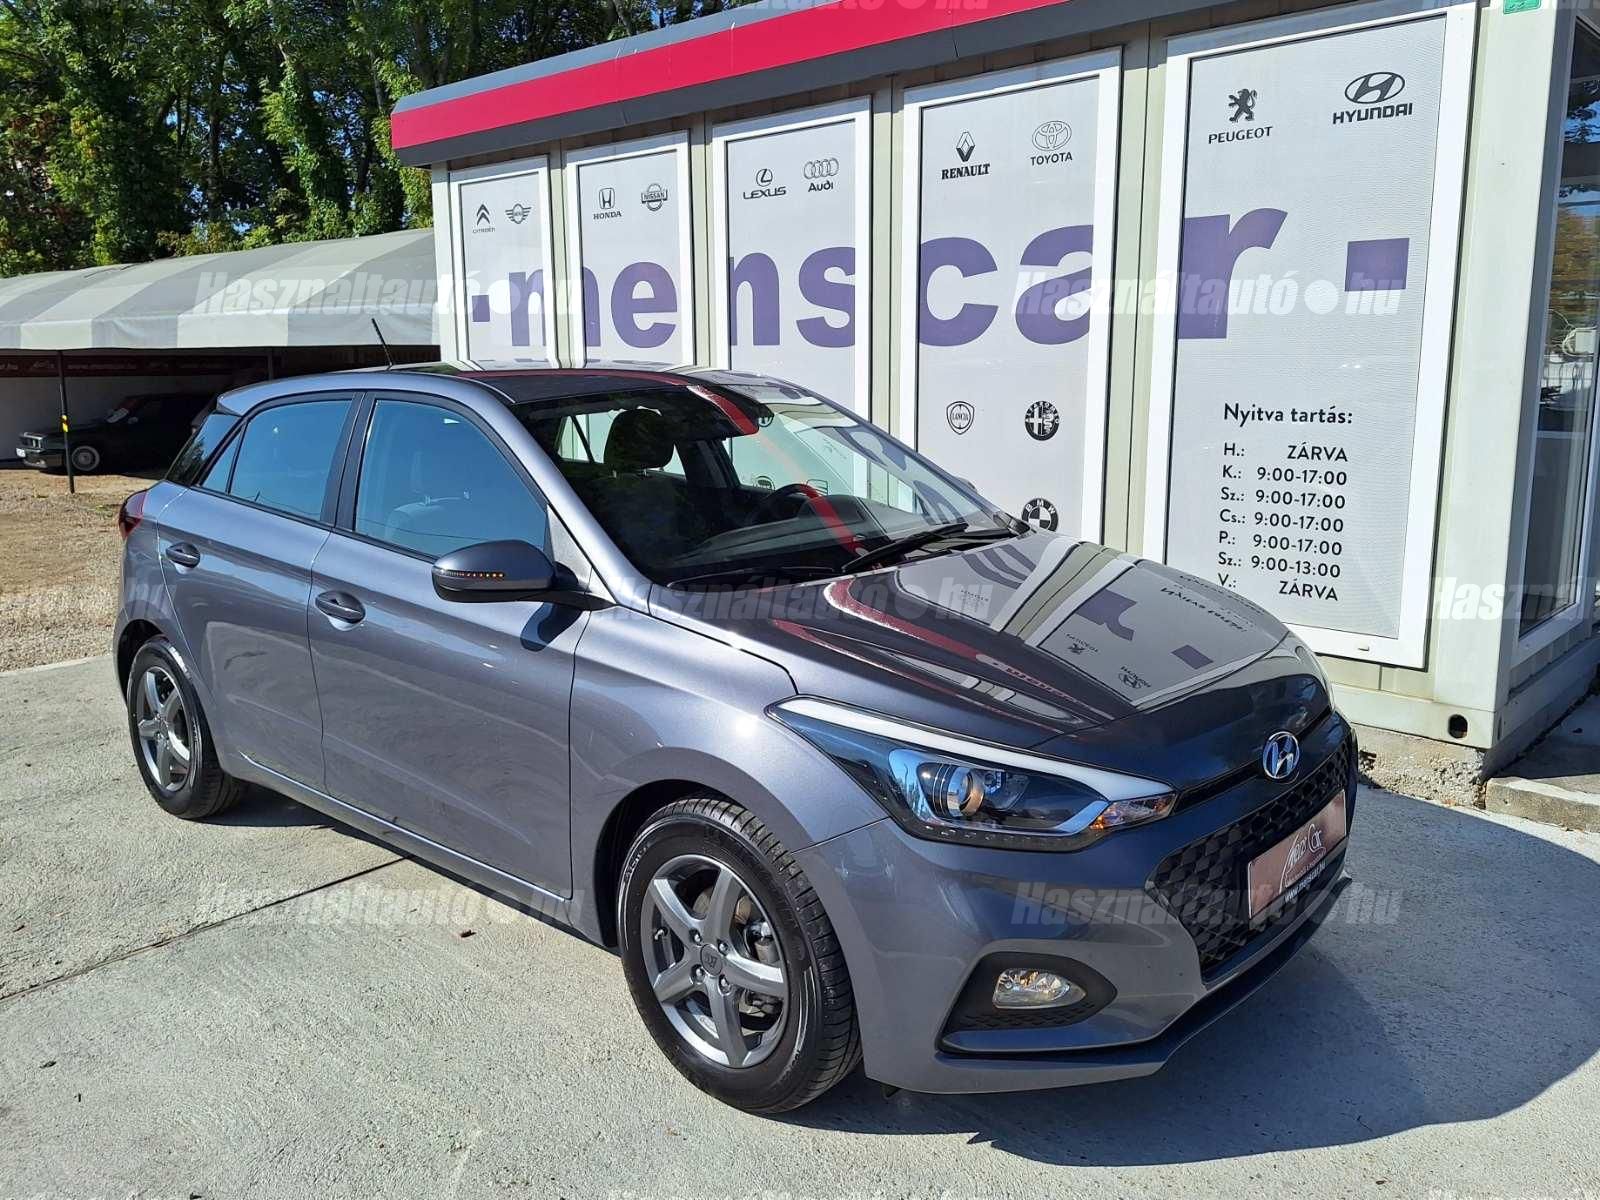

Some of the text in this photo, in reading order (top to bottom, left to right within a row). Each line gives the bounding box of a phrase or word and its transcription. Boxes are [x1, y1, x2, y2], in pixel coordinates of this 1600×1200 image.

[1332, 102, 1413, 124] HYUNDAI
[1208, 126, 1273, 144] PEUGEOT
[1030, 151, 1073, 166] TOYOTA
[941, 163, 991, 180] RENAULT
[643, 191, 665, 200] NISSAN
[743, 186, 786, 200] LEXUS
[808, 180, 834, 193] Audi
[593, 210, 622, 220] HONDA
[1224, 402, 1353, 427] Nyitva tartás:
[1223, 441, 1348, 462] H.: ZÁRVA
[1222, 464, 1347, 485] K.: 9:00-17:00
[1220, 487, 1345, 509] Sz.: 9:00-17:00
[1219, 509, 1344, 532] Cs.: 9:00-17:00
[1218, 530, 1342, 555] P.: 9:00-17:00
[1218, 552, 1341, 578] Sz.: 9:00-13:00
[1217, 572, 1237, 588] V.:
[1278, 578, 1338, 601] ZÁRVA
